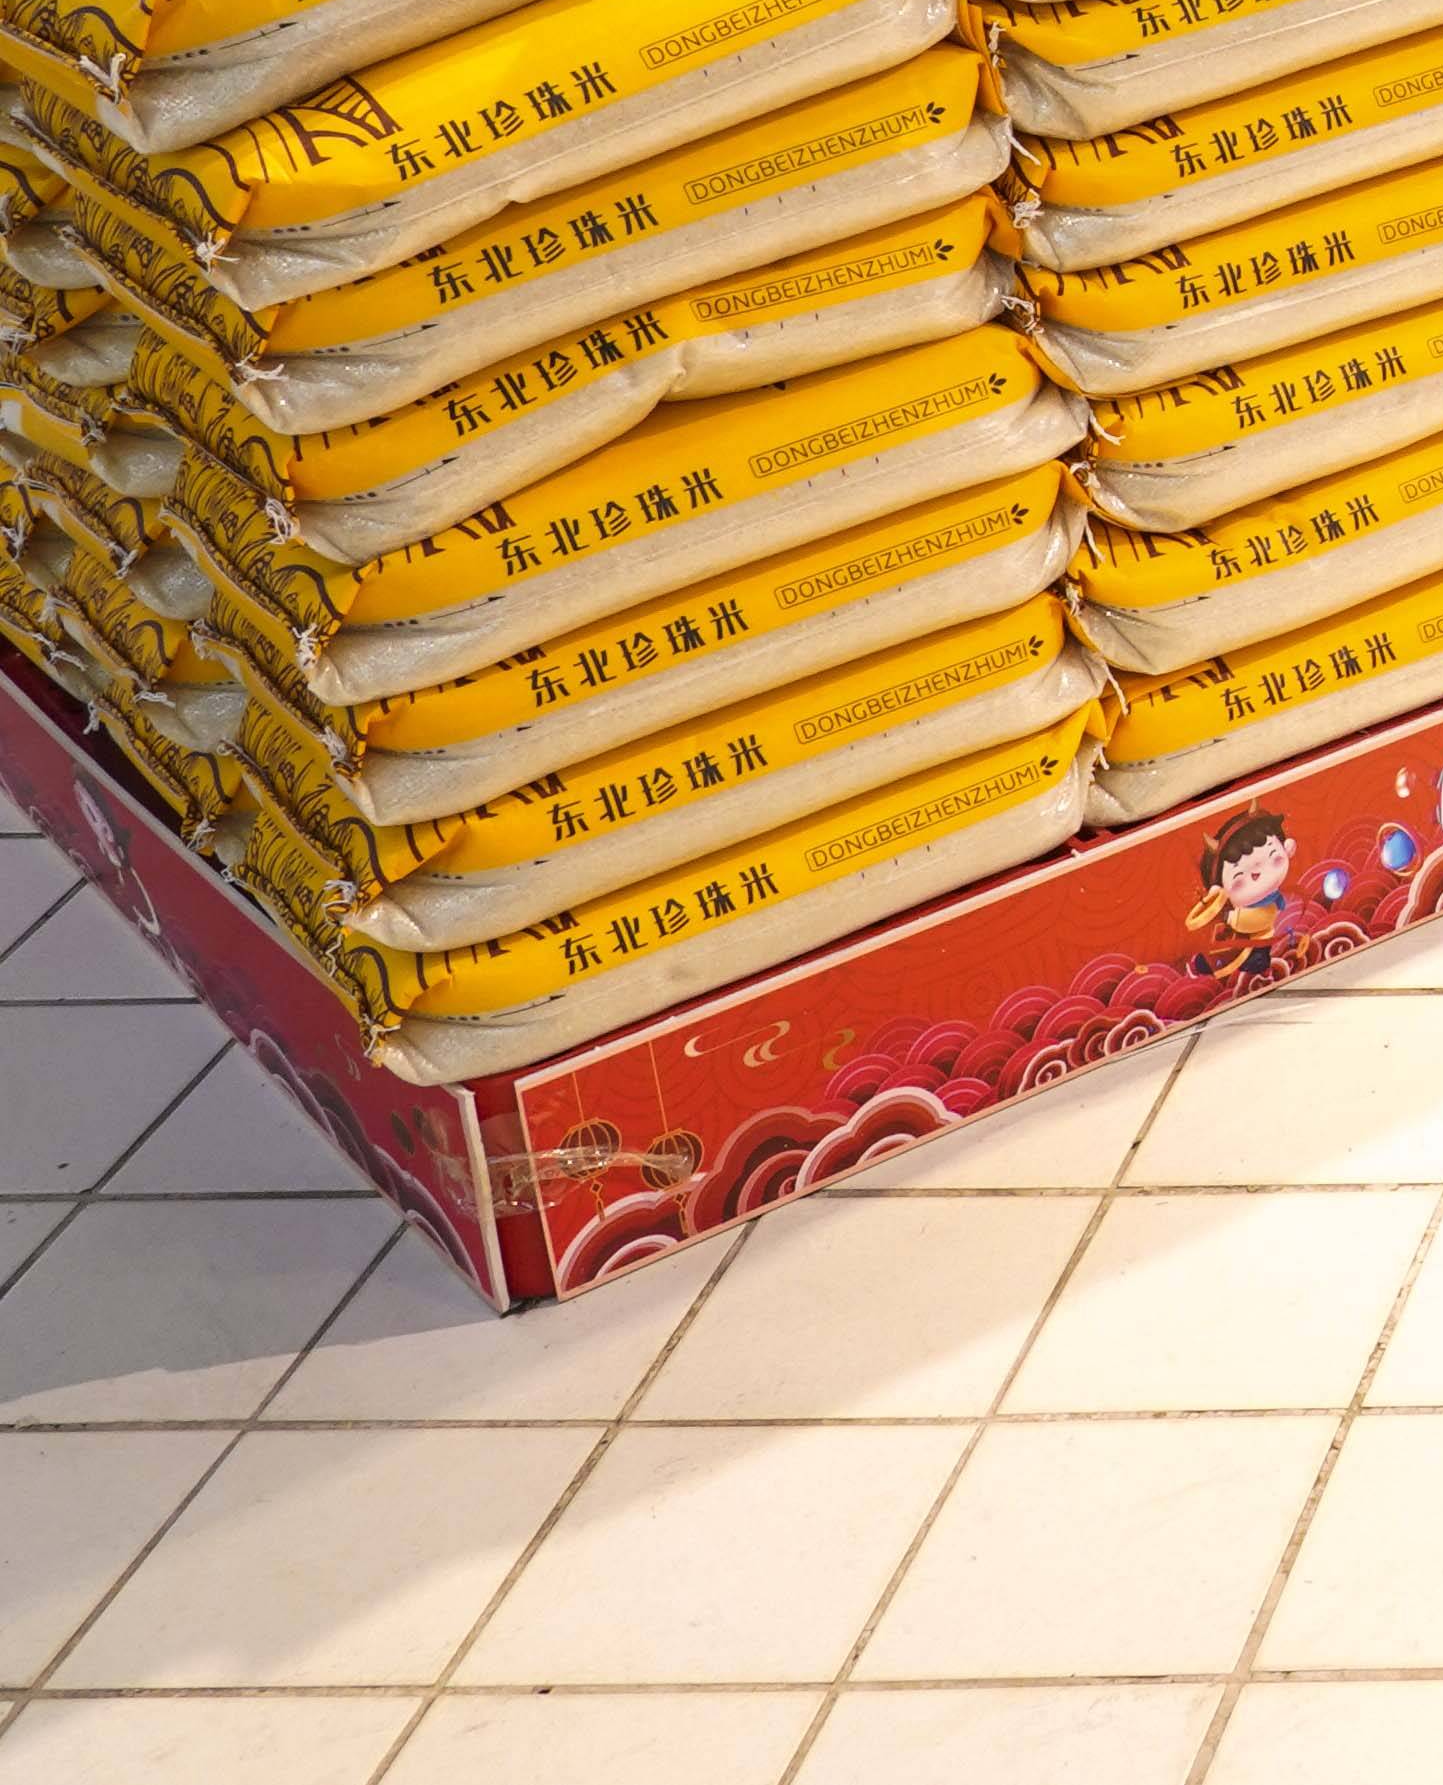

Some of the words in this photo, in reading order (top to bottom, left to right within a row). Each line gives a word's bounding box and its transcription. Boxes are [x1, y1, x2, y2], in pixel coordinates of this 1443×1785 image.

[386, 62, 617, 179] 东北珍珠米
[1175, 95, 1352, 178] 东北珍珠米
[755, 380, 988, 475] DONGBEIZHENZHUMI
[497, 468, 722, 577] 东北珍珠米
[810, 763, 1040, 870] DONGBEIZHENZHUMI
[560, 864, 777, 975] 东北珍珠米
